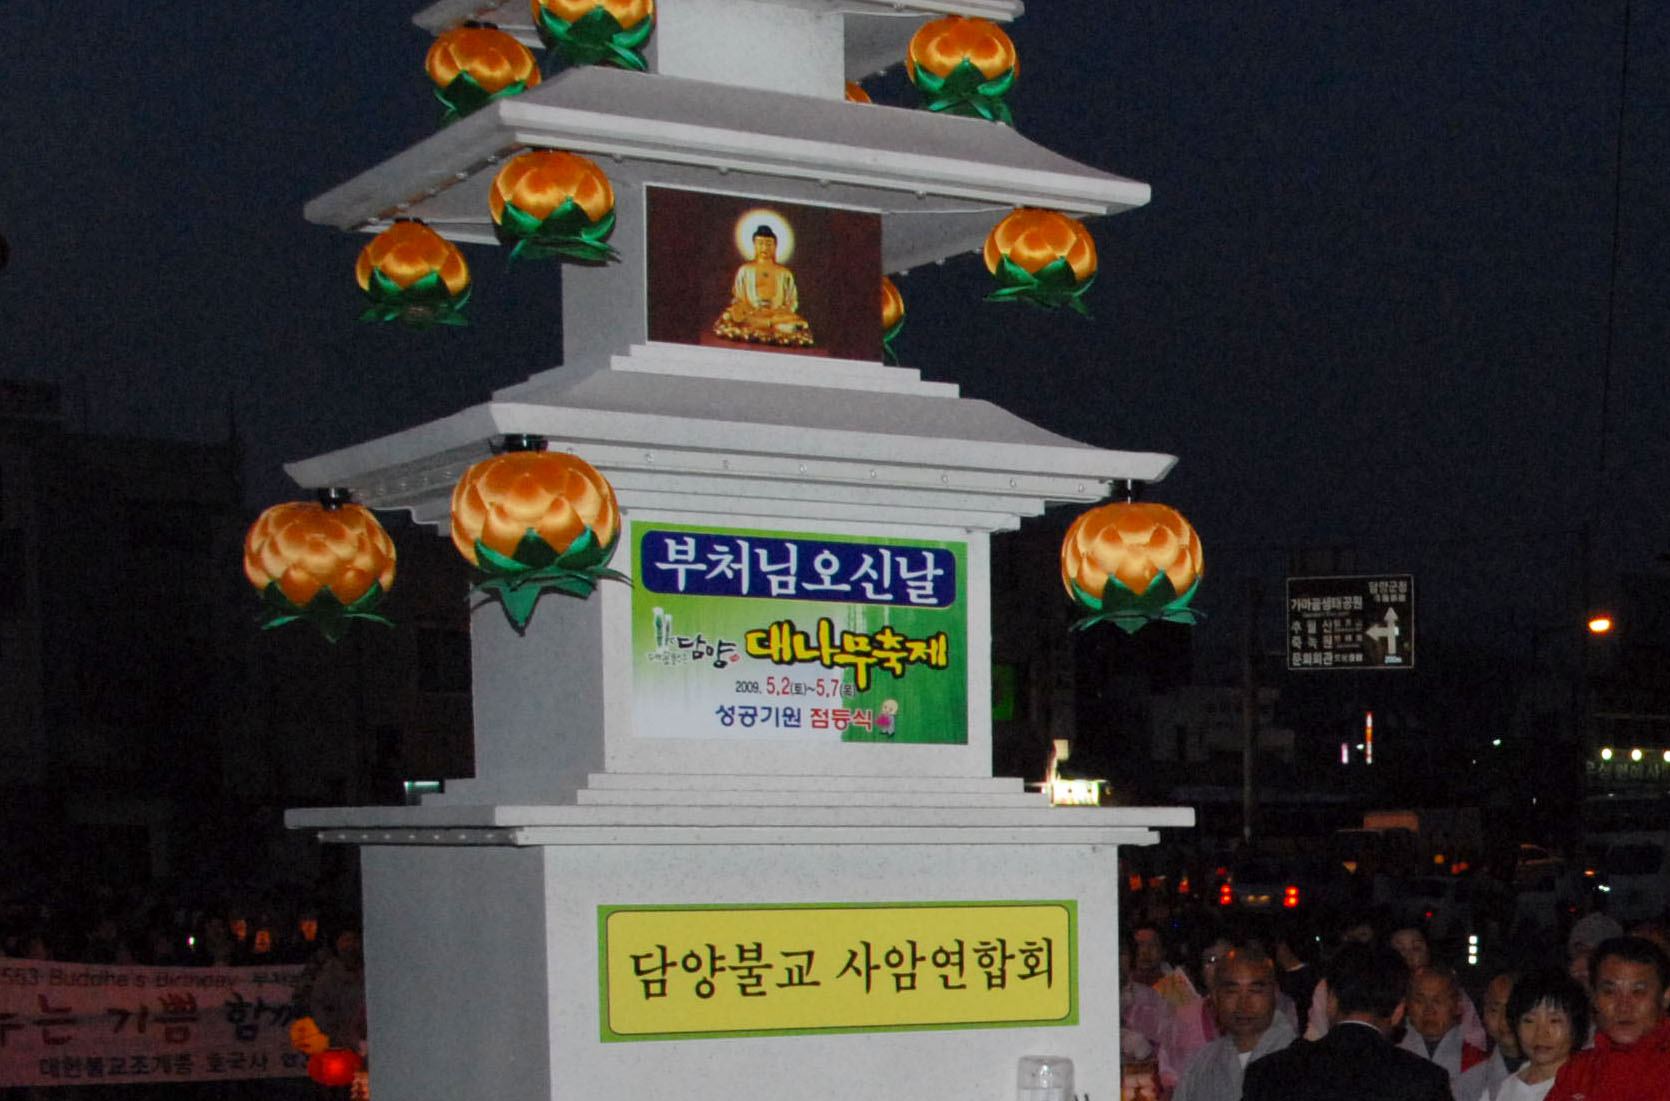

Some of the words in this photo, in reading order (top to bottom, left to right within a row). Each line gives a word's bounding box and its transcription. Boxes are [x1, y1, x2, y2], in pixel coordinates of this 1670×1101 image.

[655, 538, 943, 604] 부처님오신날
[678, 633, 737, 669] 담양
[744, 617, 949, 692] 대나무축제
[736, 680, 763, 694] 2009.
[716, 705, 802, 728] 성공기원
[810, 708, 873, 731] 점등식
[630, 942, 822, 1000] 담양불교
[836, 936, 1055, 995] 사암연합회
[107, 992, 198, 1043] 기쁨
